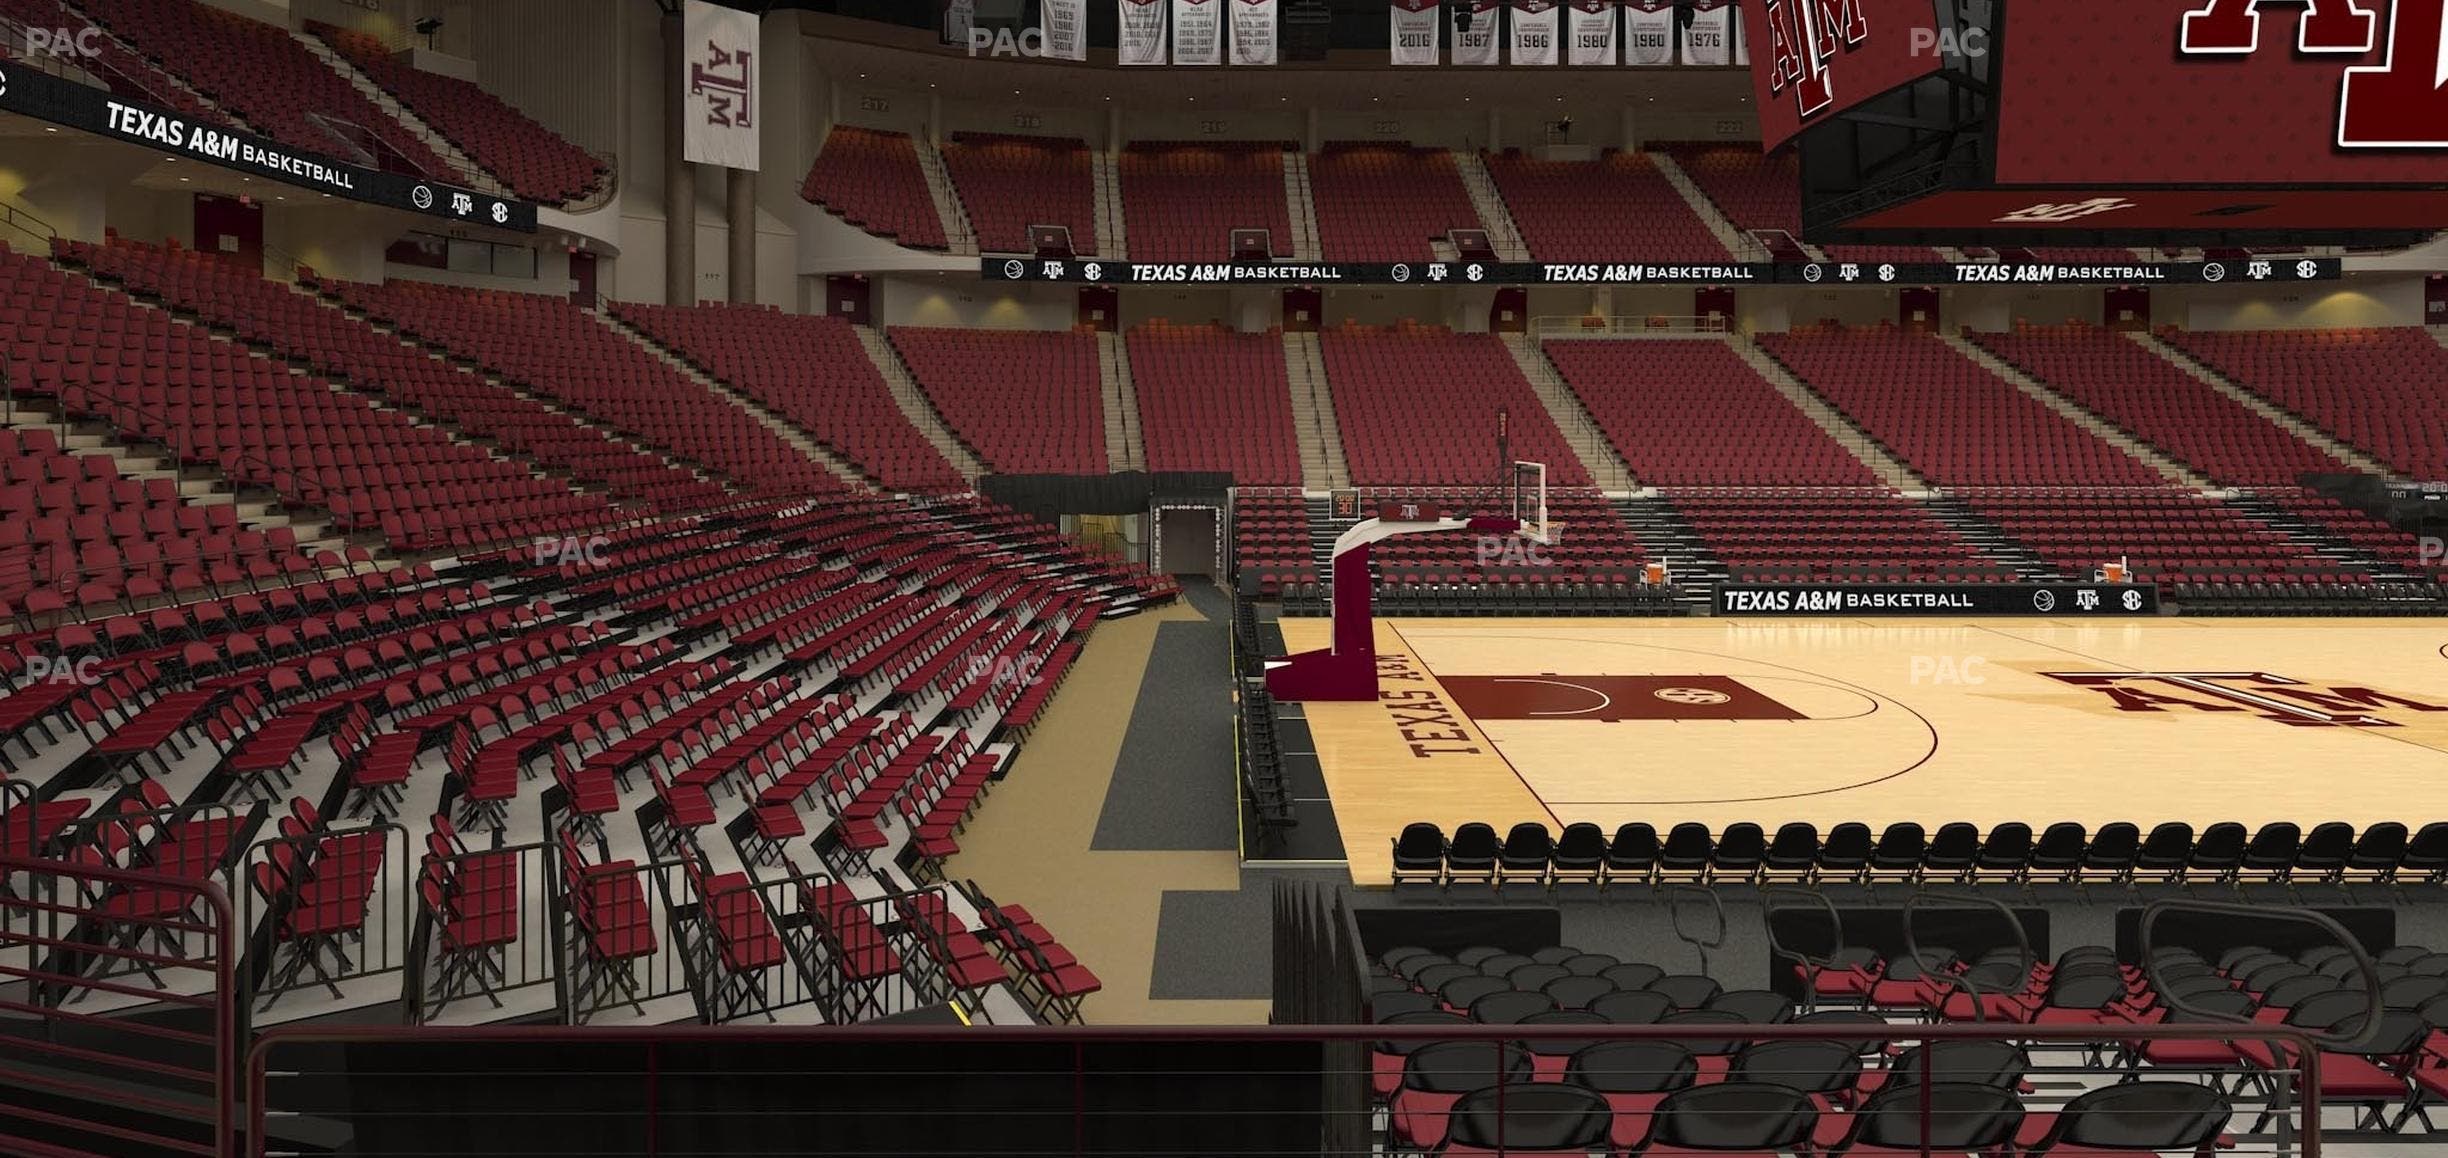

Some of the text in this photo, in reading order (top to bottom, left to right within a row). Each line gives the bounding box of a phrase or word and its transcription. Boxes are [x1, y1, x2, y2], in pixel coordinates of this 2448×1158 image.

[1399, 33, 1430, 47] 2016
[1459, 33, 1490, 47] 1987
[1517, 34, 1548, 48] 1986
[1577, 34, 1608, 48] 1980
[1633, 33, 1664, 48] 1980
[1689, 33, 1720, 47] 1976
[862, 97, 889, 111] 217
[107, 101, 353, 189] TEXAS A&M BASKETBALL
[1131, 265, 1341, 281] TEXAS A&M BASKETBALL
[1544, 265, 1753, 281] TEXAS A&M BASKETBALL
[1955, 265, 2164, 281] TEXAS A&M BASKETBALL
[2296, 259, 2317, 279] SEC
[1338, 502, 1352, 514] 30
[1724, 591, 1974, 611] TEXAS A&M BASKETBALL
[2122, 589, 2142, 611] SEC
[1378, 691, 1482, 758] TEXAS
